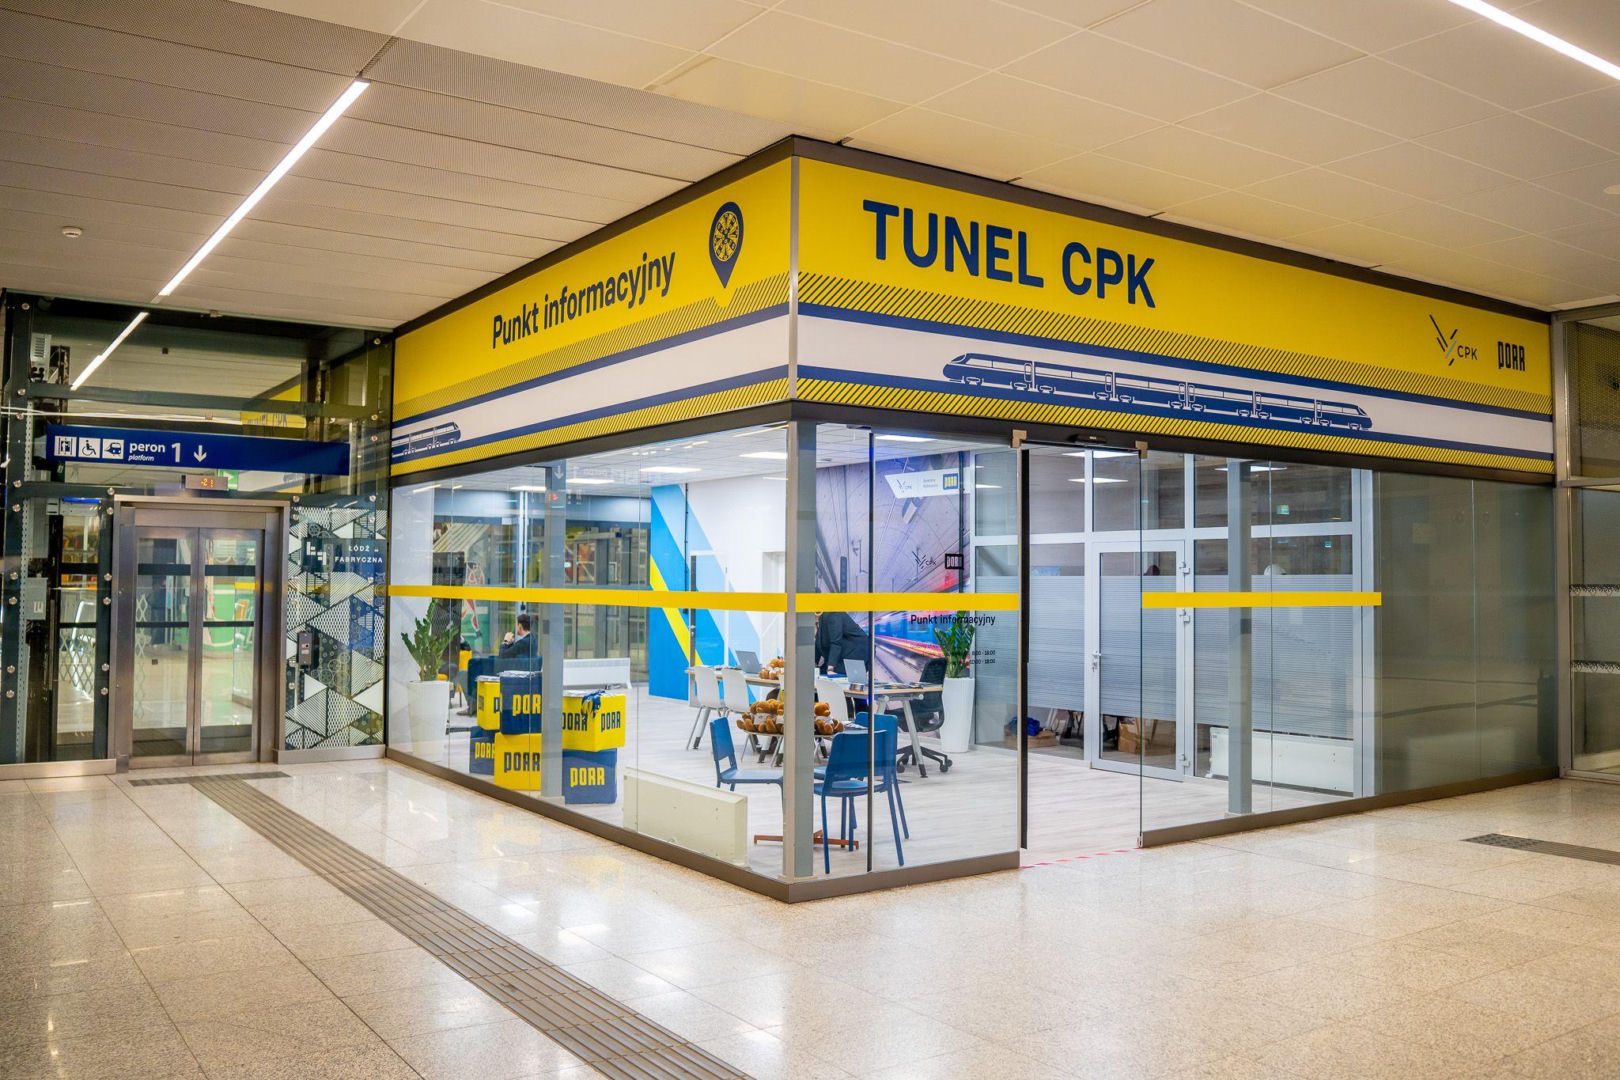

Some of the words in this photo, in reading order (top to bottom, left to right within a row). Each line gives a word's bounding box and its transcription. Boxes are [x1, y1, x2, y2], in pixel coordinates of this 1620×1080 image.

[862, 199, 1044, 288] TUNEL
[1062, 241, 1156, 308] CPK
[493, 301, 538, 349] Punkt
[544, 252, 675, 329] informacyjny
[1457, 345, 1478, 361] CPK
[128, 454, 155, 462] platform
[129, 442, 165, 454] peron
[172, 442, 181, 463] 1
[348, 544, 370, 552] ŁÓDŹ
[910, 614, 937, 625] Punkt
[940, 614, 996, 627] informacyjny
